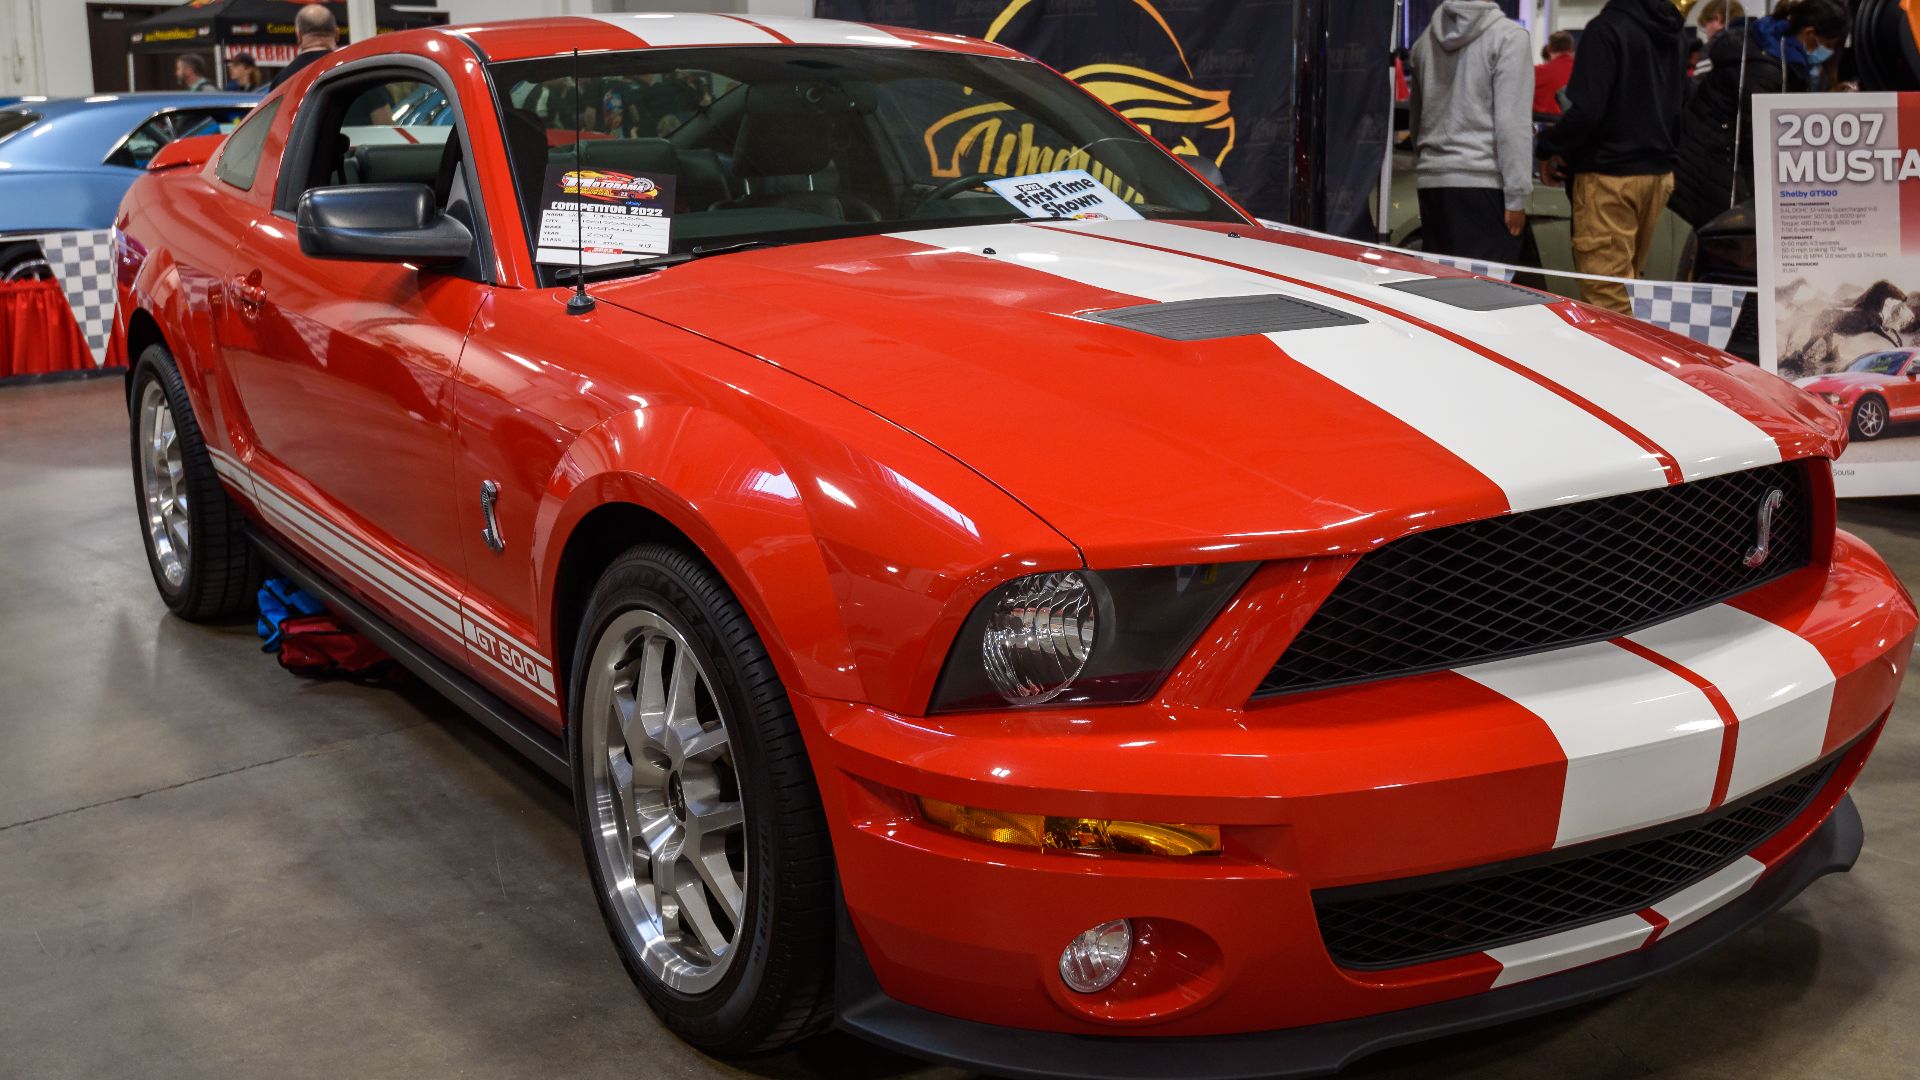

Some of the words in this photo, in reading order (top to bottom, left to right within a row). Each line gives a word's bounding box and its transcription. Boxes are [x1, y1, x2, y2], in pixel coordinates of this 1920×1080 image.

[1777, 112, 1884, 146] 2007
[1778, 148, 1920, 184] MUSTA
[1014, 187, 1058, 208] First
[1048, 178, 1096, 196] Time
[1042, 194, 1103, 217] Shown
[1780, 190, 1808, 198] Shelby
[551, 201, 627, 214] COMPETITOR
[630, 207, 663, 216] 2022
[475, 626, 497, 656] GT
[499, 640, 539, 683] 500
